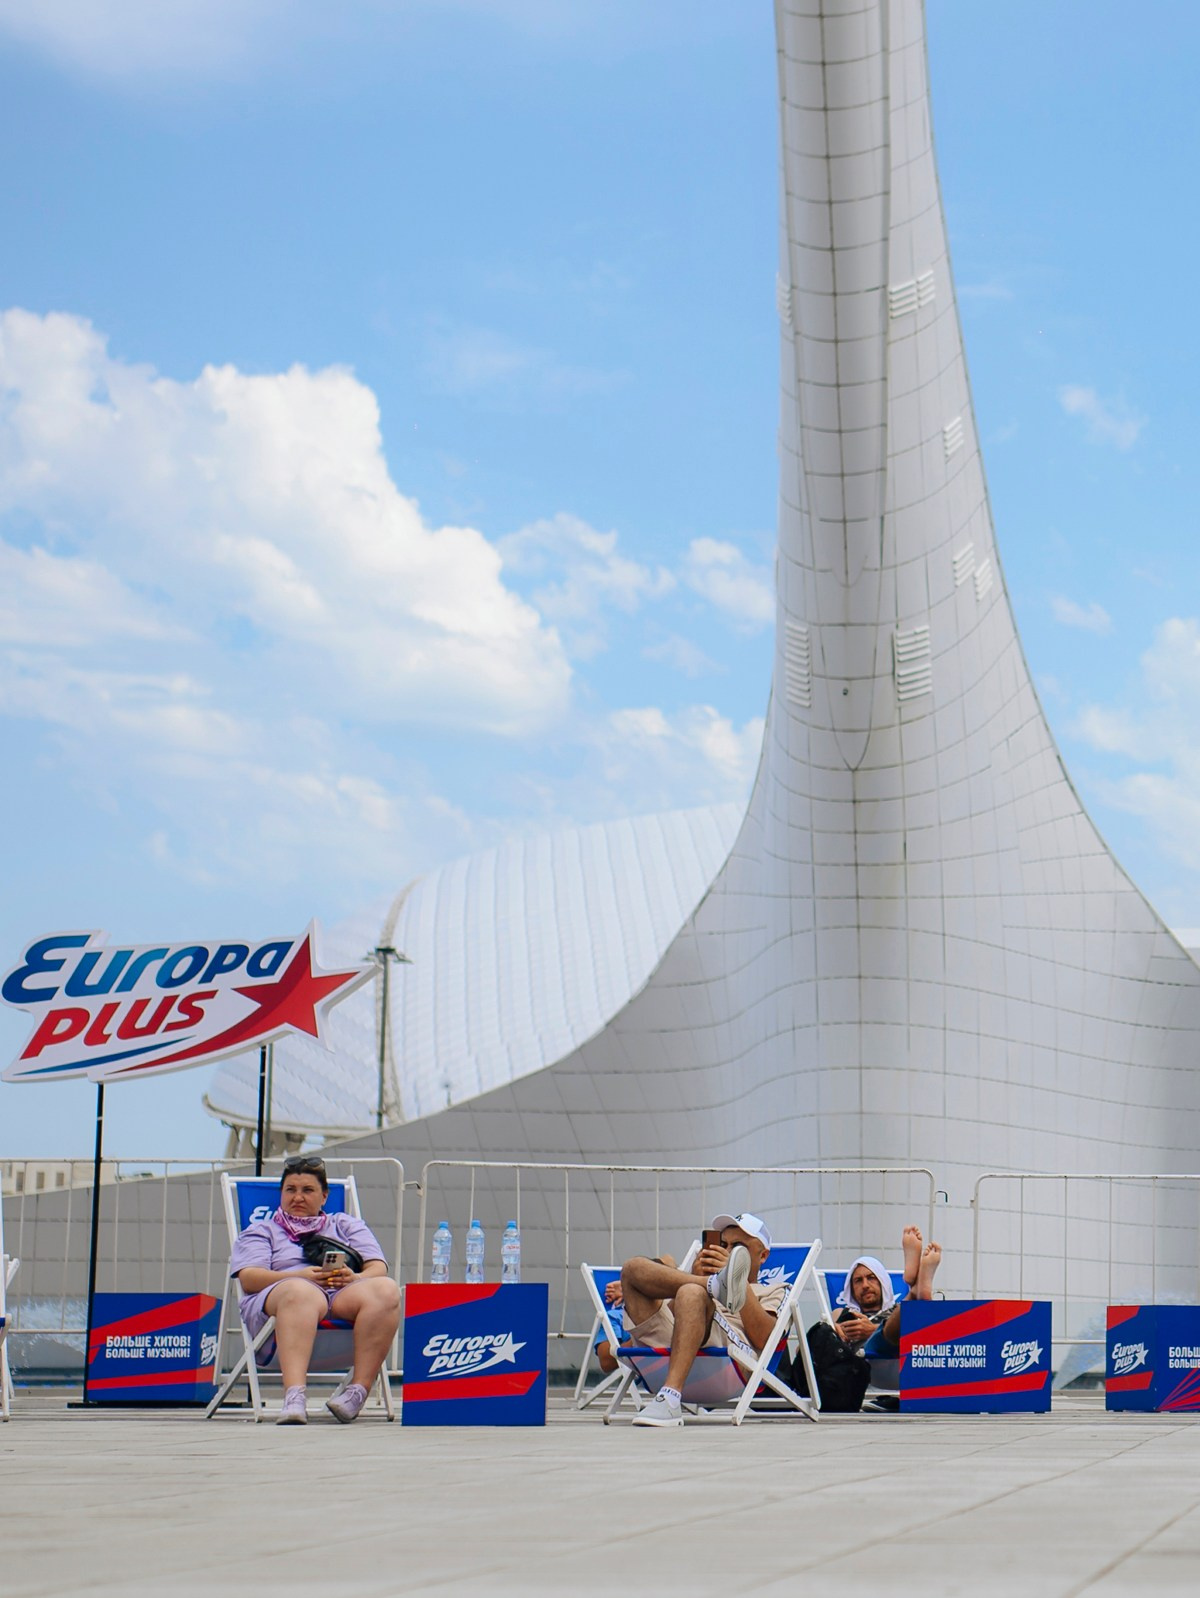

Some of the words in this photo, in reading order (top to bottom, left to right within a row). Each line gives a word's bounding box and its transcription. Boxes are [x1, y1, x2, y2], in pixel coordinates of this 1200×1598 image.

[106, 1336, 152, 1347] БОЛЬШЕ
[153, 1335, 191, 1347] ХИТОВ!
[105, 1348, 145, 1358] БОЛЬШЕ
[146, 1348, 191, 1358] МУЗЫКИ!
[911, 1344, 951, 1356] БОЛЬШЕ
[953, 1344, 986, 1356] ХИТОВ!
[911, 1357, 946, 1368] БОЛЬШЕ
[947, 1357, 986, 1368] МУЗЫКИ!
